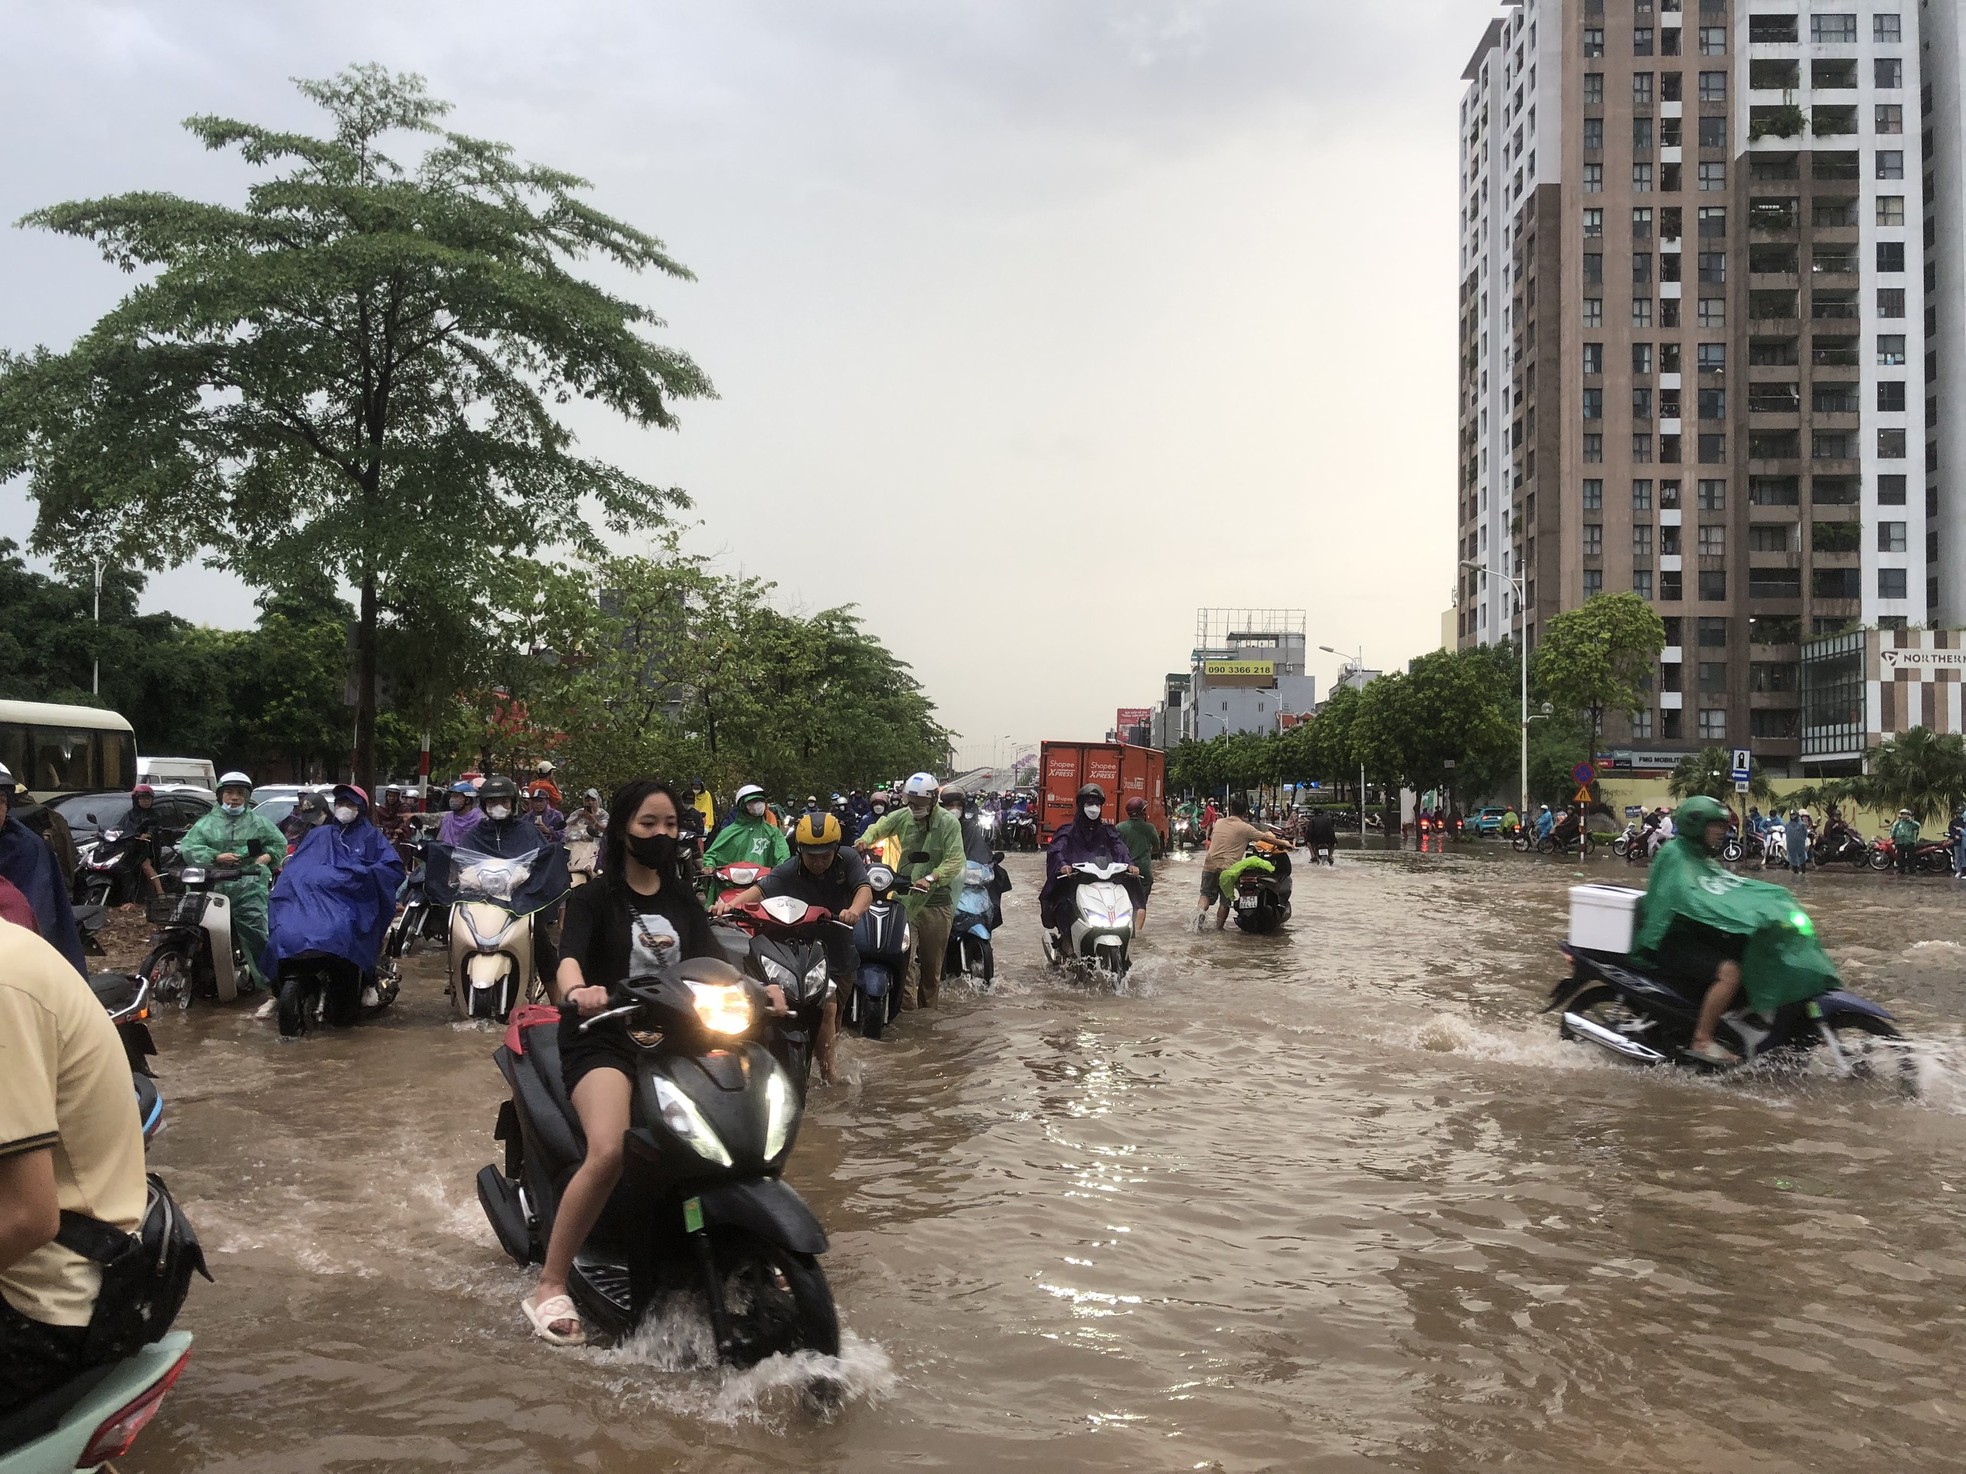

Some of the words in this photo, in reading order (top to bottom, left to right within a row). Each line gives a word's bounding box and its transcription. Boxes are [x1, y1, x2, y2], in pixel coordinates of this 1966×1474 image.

[1208, 666, 1225, 674] 090
[1228, 666, 1251, 674] 3366
[1253, 666, 1271, 674] 218
[1049, 760, 1075, 769] Shopee
[1090, 761, 1117, 770] Shopee
[1048, 768, 1075, 777] XPRESS
[1089, 770, 1117, 779] XPRESS
